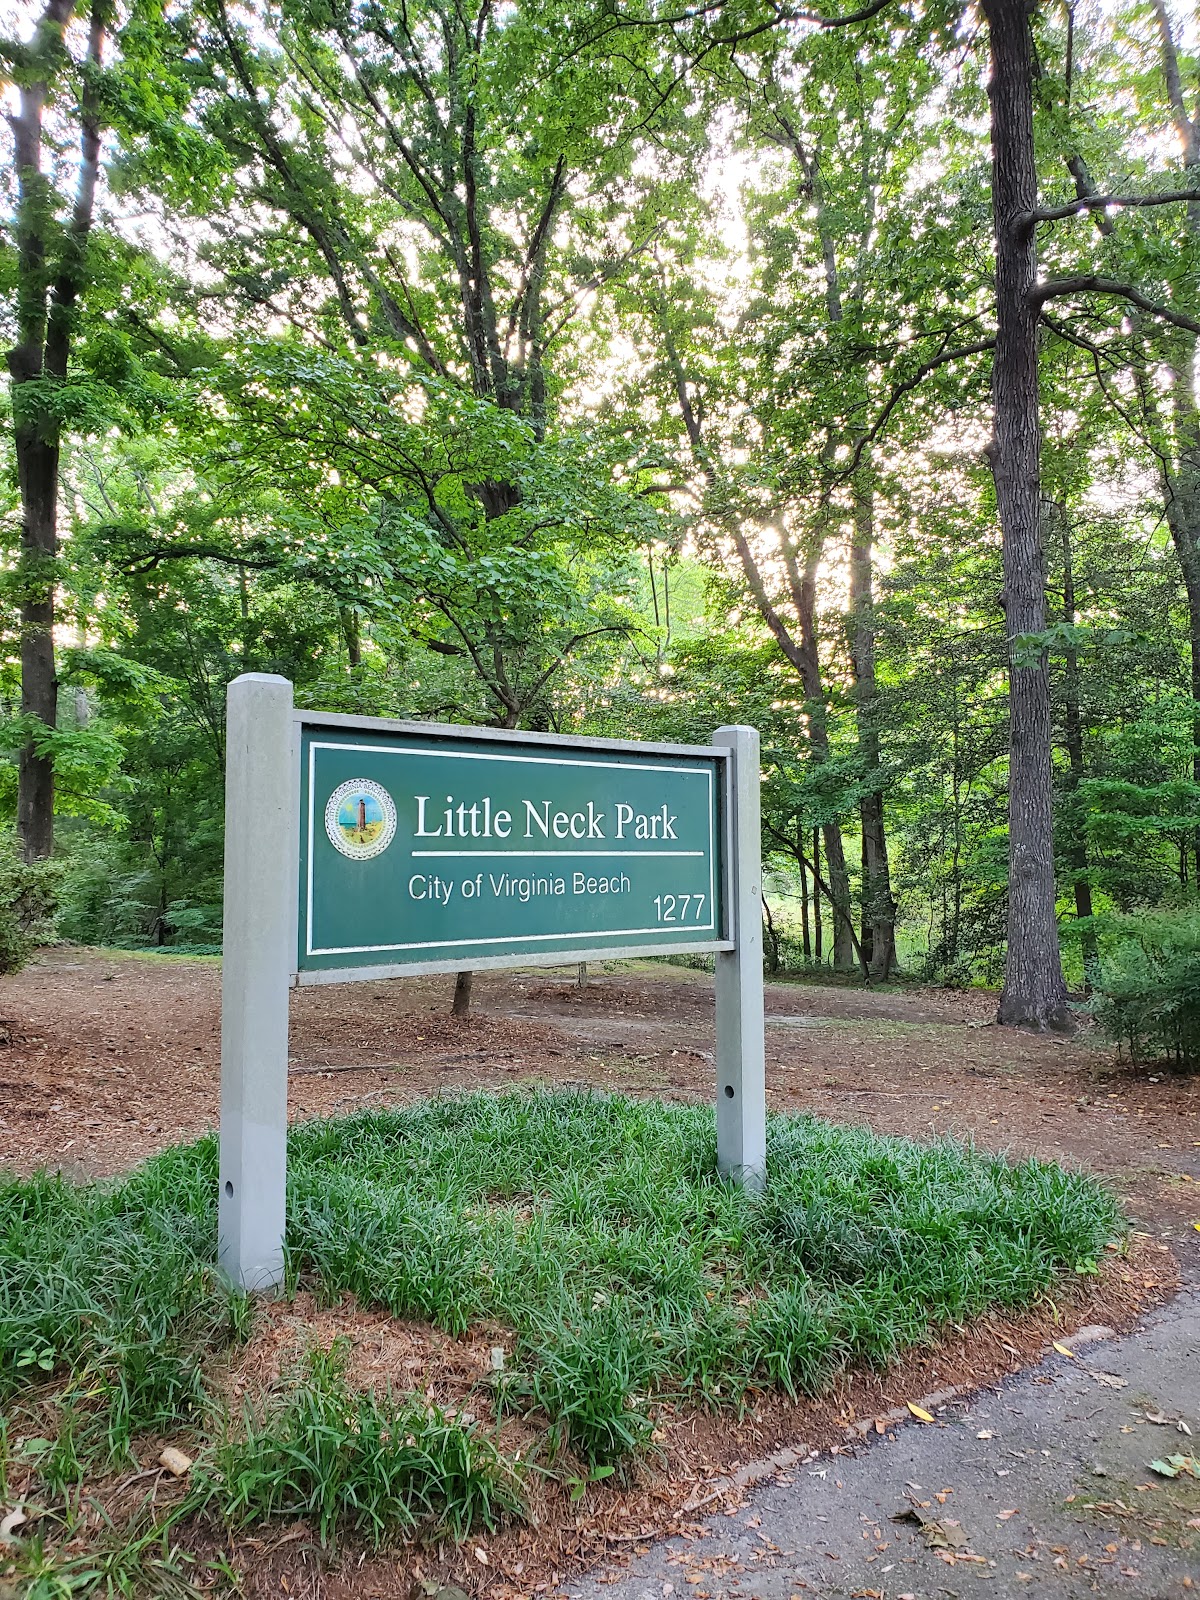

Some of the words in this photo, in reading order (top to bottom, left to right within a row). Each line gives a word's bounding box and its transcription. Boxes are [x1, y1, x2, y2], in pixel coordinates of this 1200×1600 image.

[413, 795, 512, 838] Little
[521, 799, 606, 839] Neck
[614, 802, 679, 840] Park
[408, 874, 454, 906] City
[461, 874, 483, 898] of
[489, 872, 566, 903] Virginia
[573, 871, 632, 896] Beach
[652, 893, 707, 922] 1277
